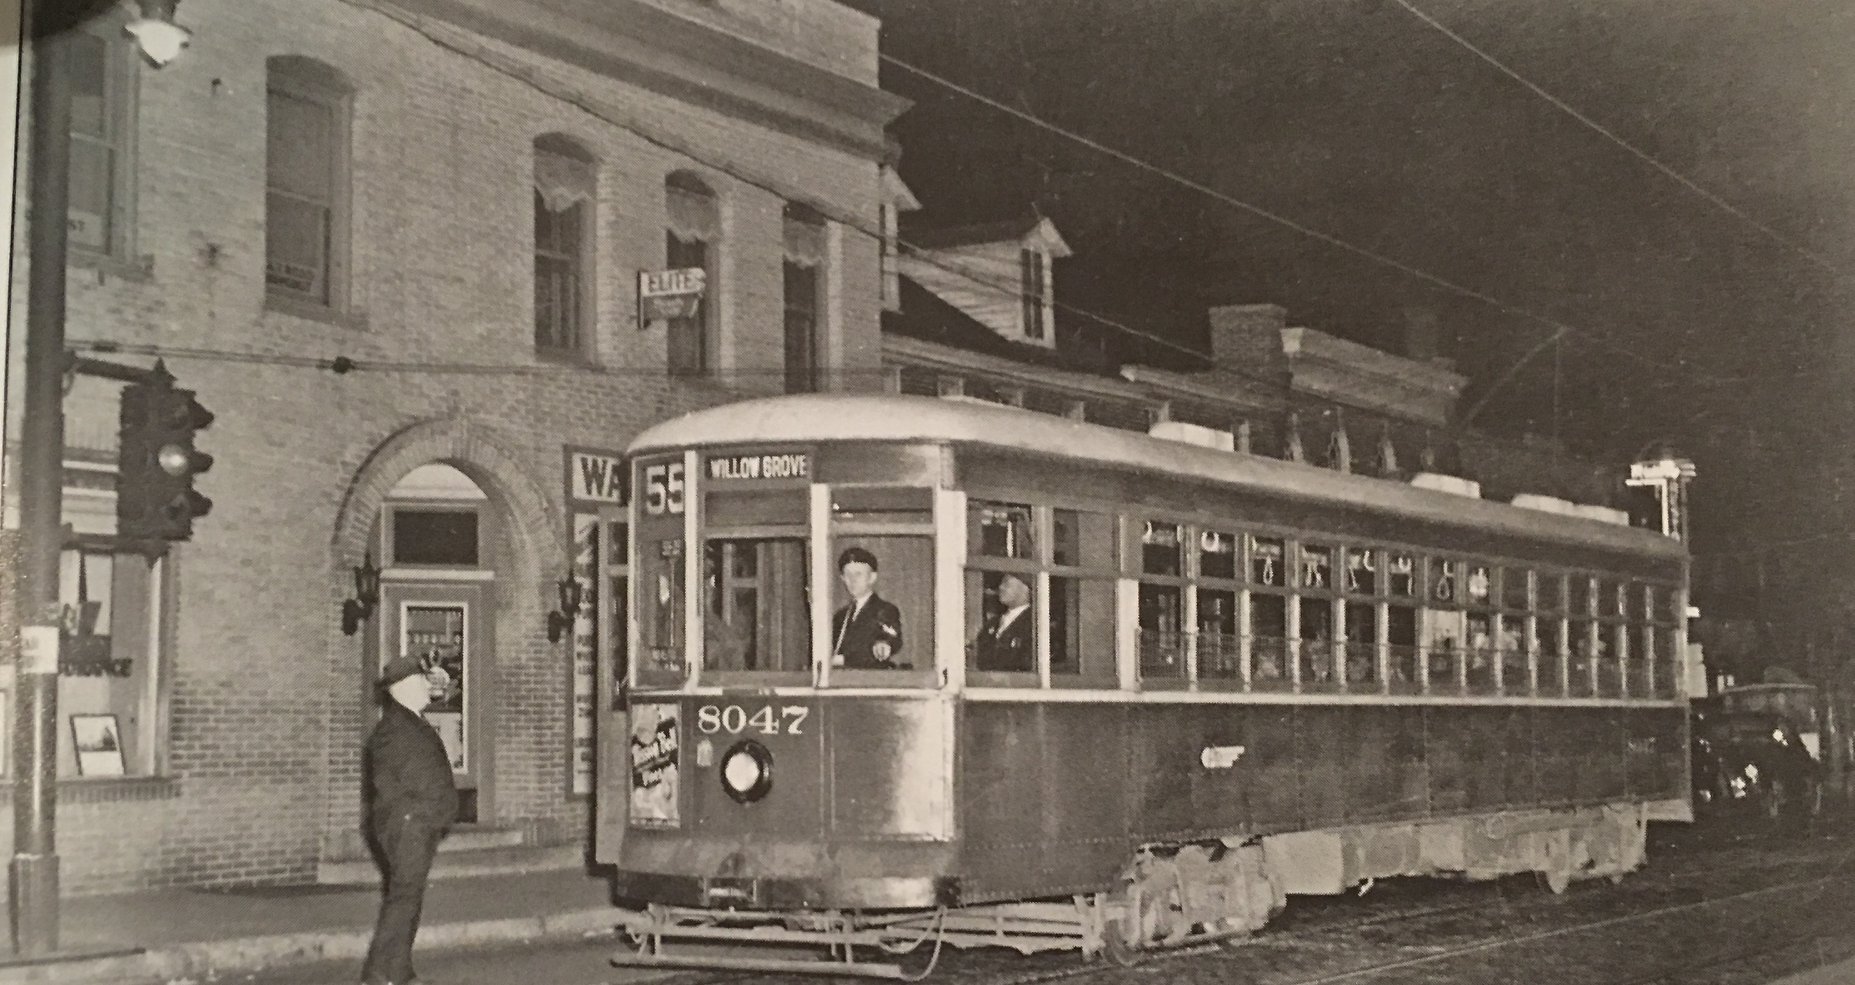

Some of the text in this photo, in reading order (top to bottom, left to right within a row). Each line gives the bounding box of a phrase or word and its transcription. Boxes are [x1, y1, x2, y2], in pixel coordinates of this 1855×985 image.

[647, 270, 704, 292] ELITE
[710, 454, 807, 479] WILLOW GROVE
[645, 462, 684, 515] 55
[697, 704, 810, 735] 8047
